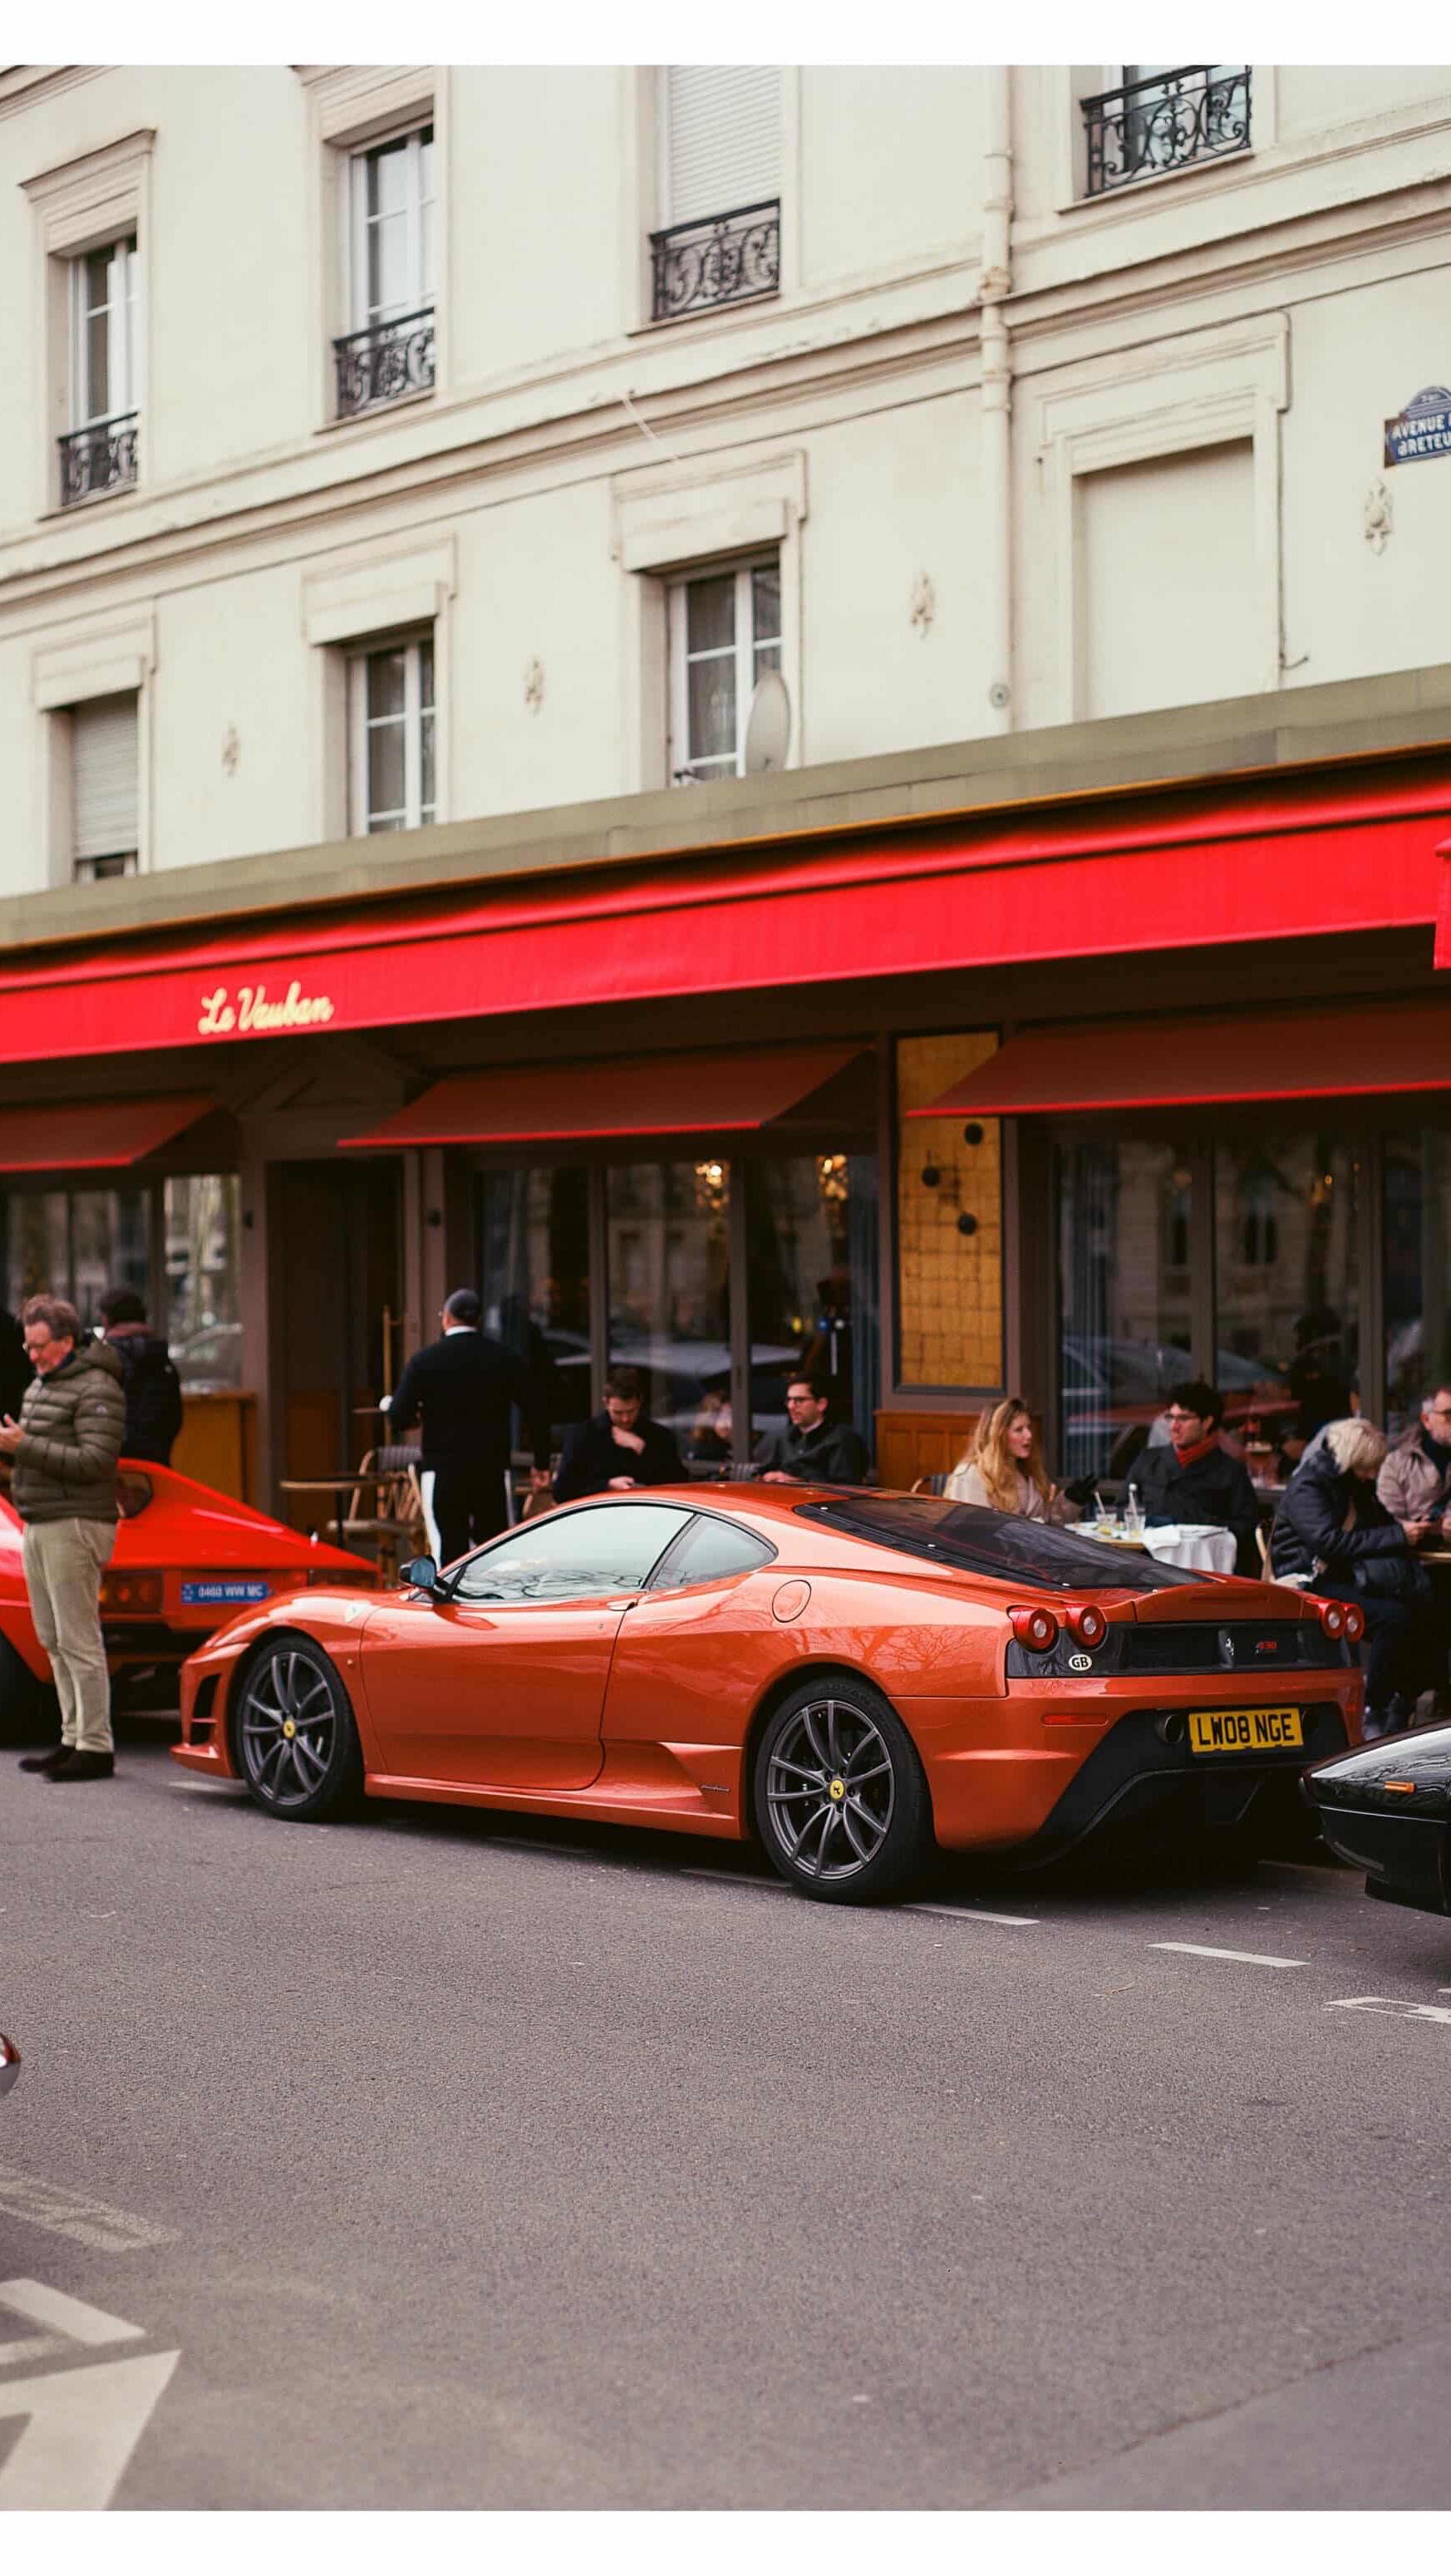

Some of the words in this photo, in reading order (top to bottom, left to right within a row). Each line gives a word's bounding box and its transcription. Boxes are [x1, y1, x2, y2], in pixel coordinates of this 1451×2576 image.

[1391, 414, 1445, 440] AVENUE
[198, 987, 236, 1035] Le
[238, 981, 334, 1032] Vauban
[1071, 1656, 1089, 1668] GB
[1197, 1715, 1251, 1745] LW08
[1254, 1713, 1295, 1743] NGE
